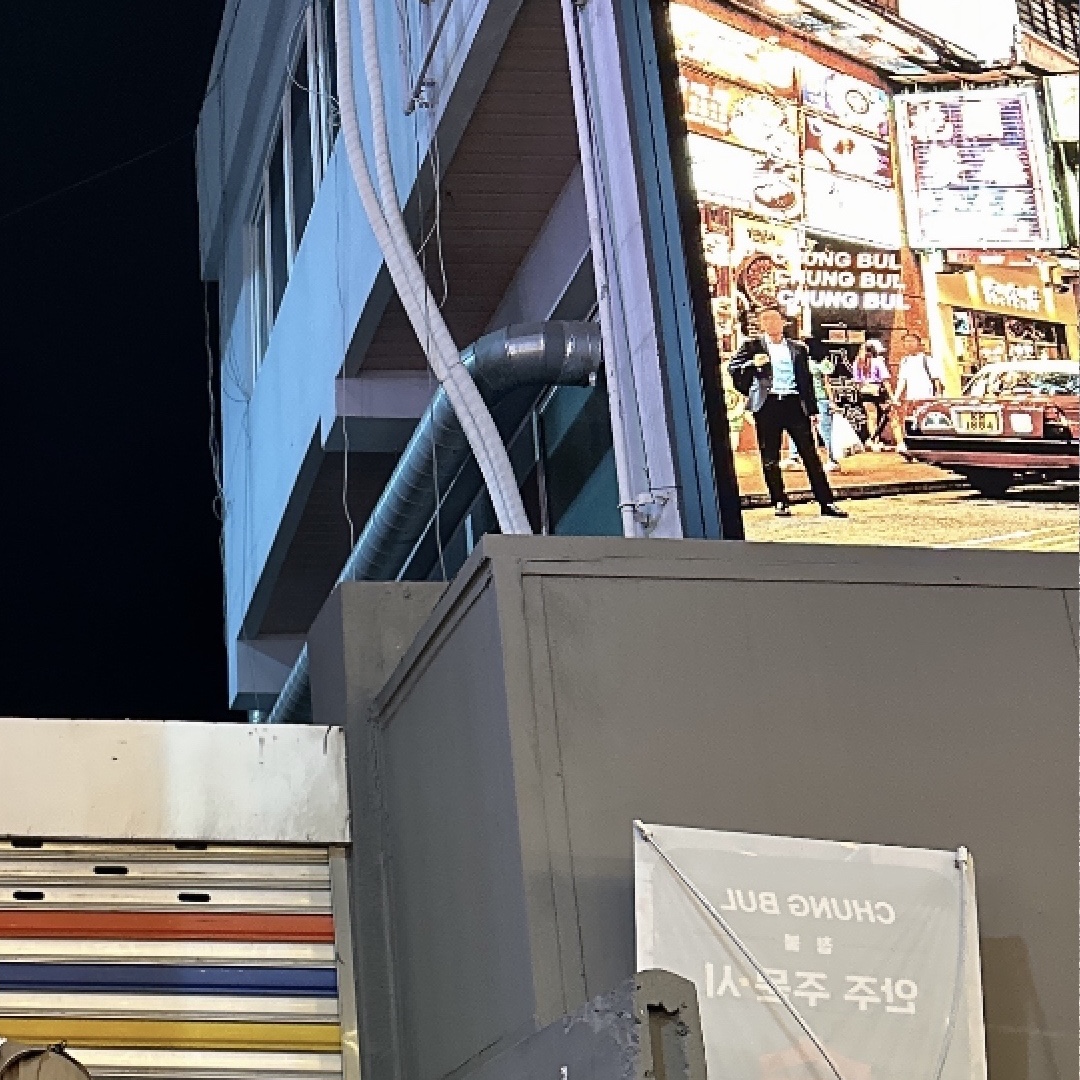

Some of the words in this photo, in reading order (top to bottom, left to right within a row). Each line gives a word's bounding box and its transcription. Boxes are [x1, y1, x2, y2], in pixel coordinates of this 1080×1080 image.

[857, 252, 899, 268] BUL
[860, 272, 905, 288] BUL
[863, 291, 911, 309] BUL
